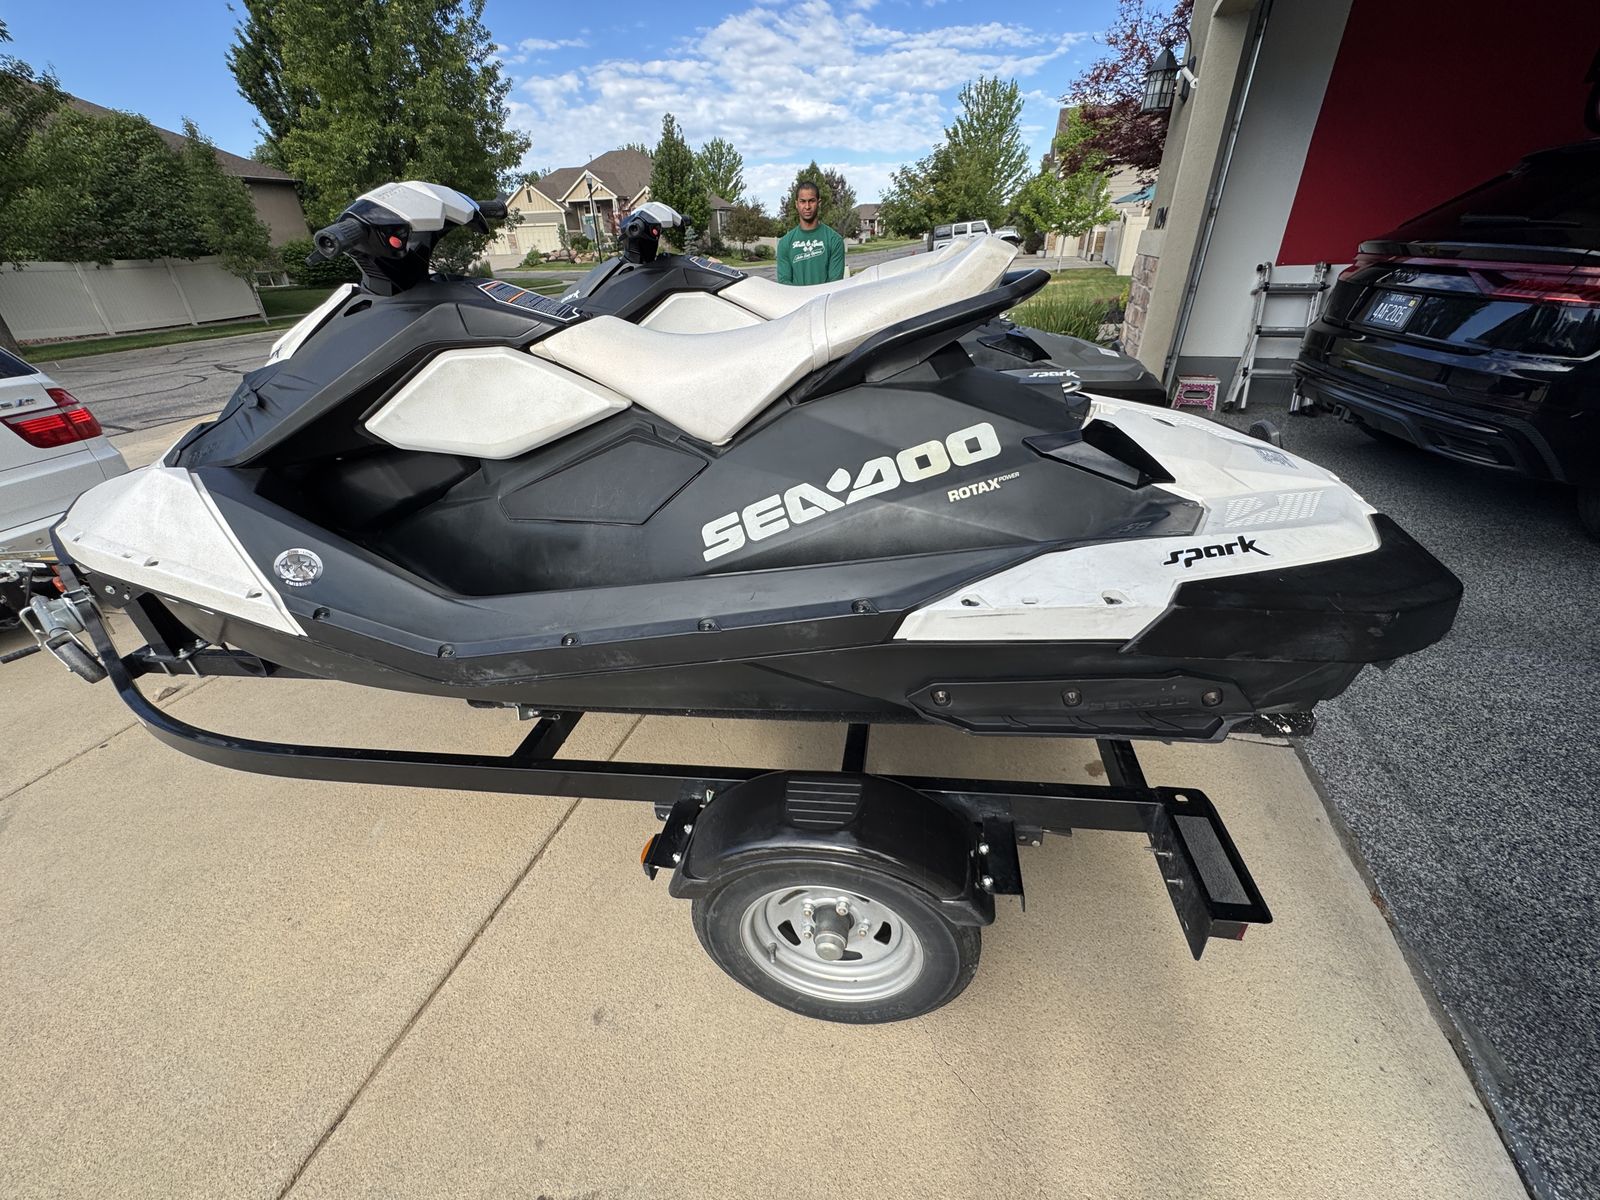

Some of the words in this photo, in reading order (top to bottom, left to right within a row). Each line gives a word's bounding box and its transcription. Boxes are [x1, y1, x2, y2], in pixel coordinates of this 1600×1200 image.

[1371, 302, 1408, 323] 4AF205
[1028, 369, 1081, 379] spark
[947, 477, 1001, 503] ROTAX
[998, 471, 1021, 483] POWER
[1163, 535, 1272, 568] spark
